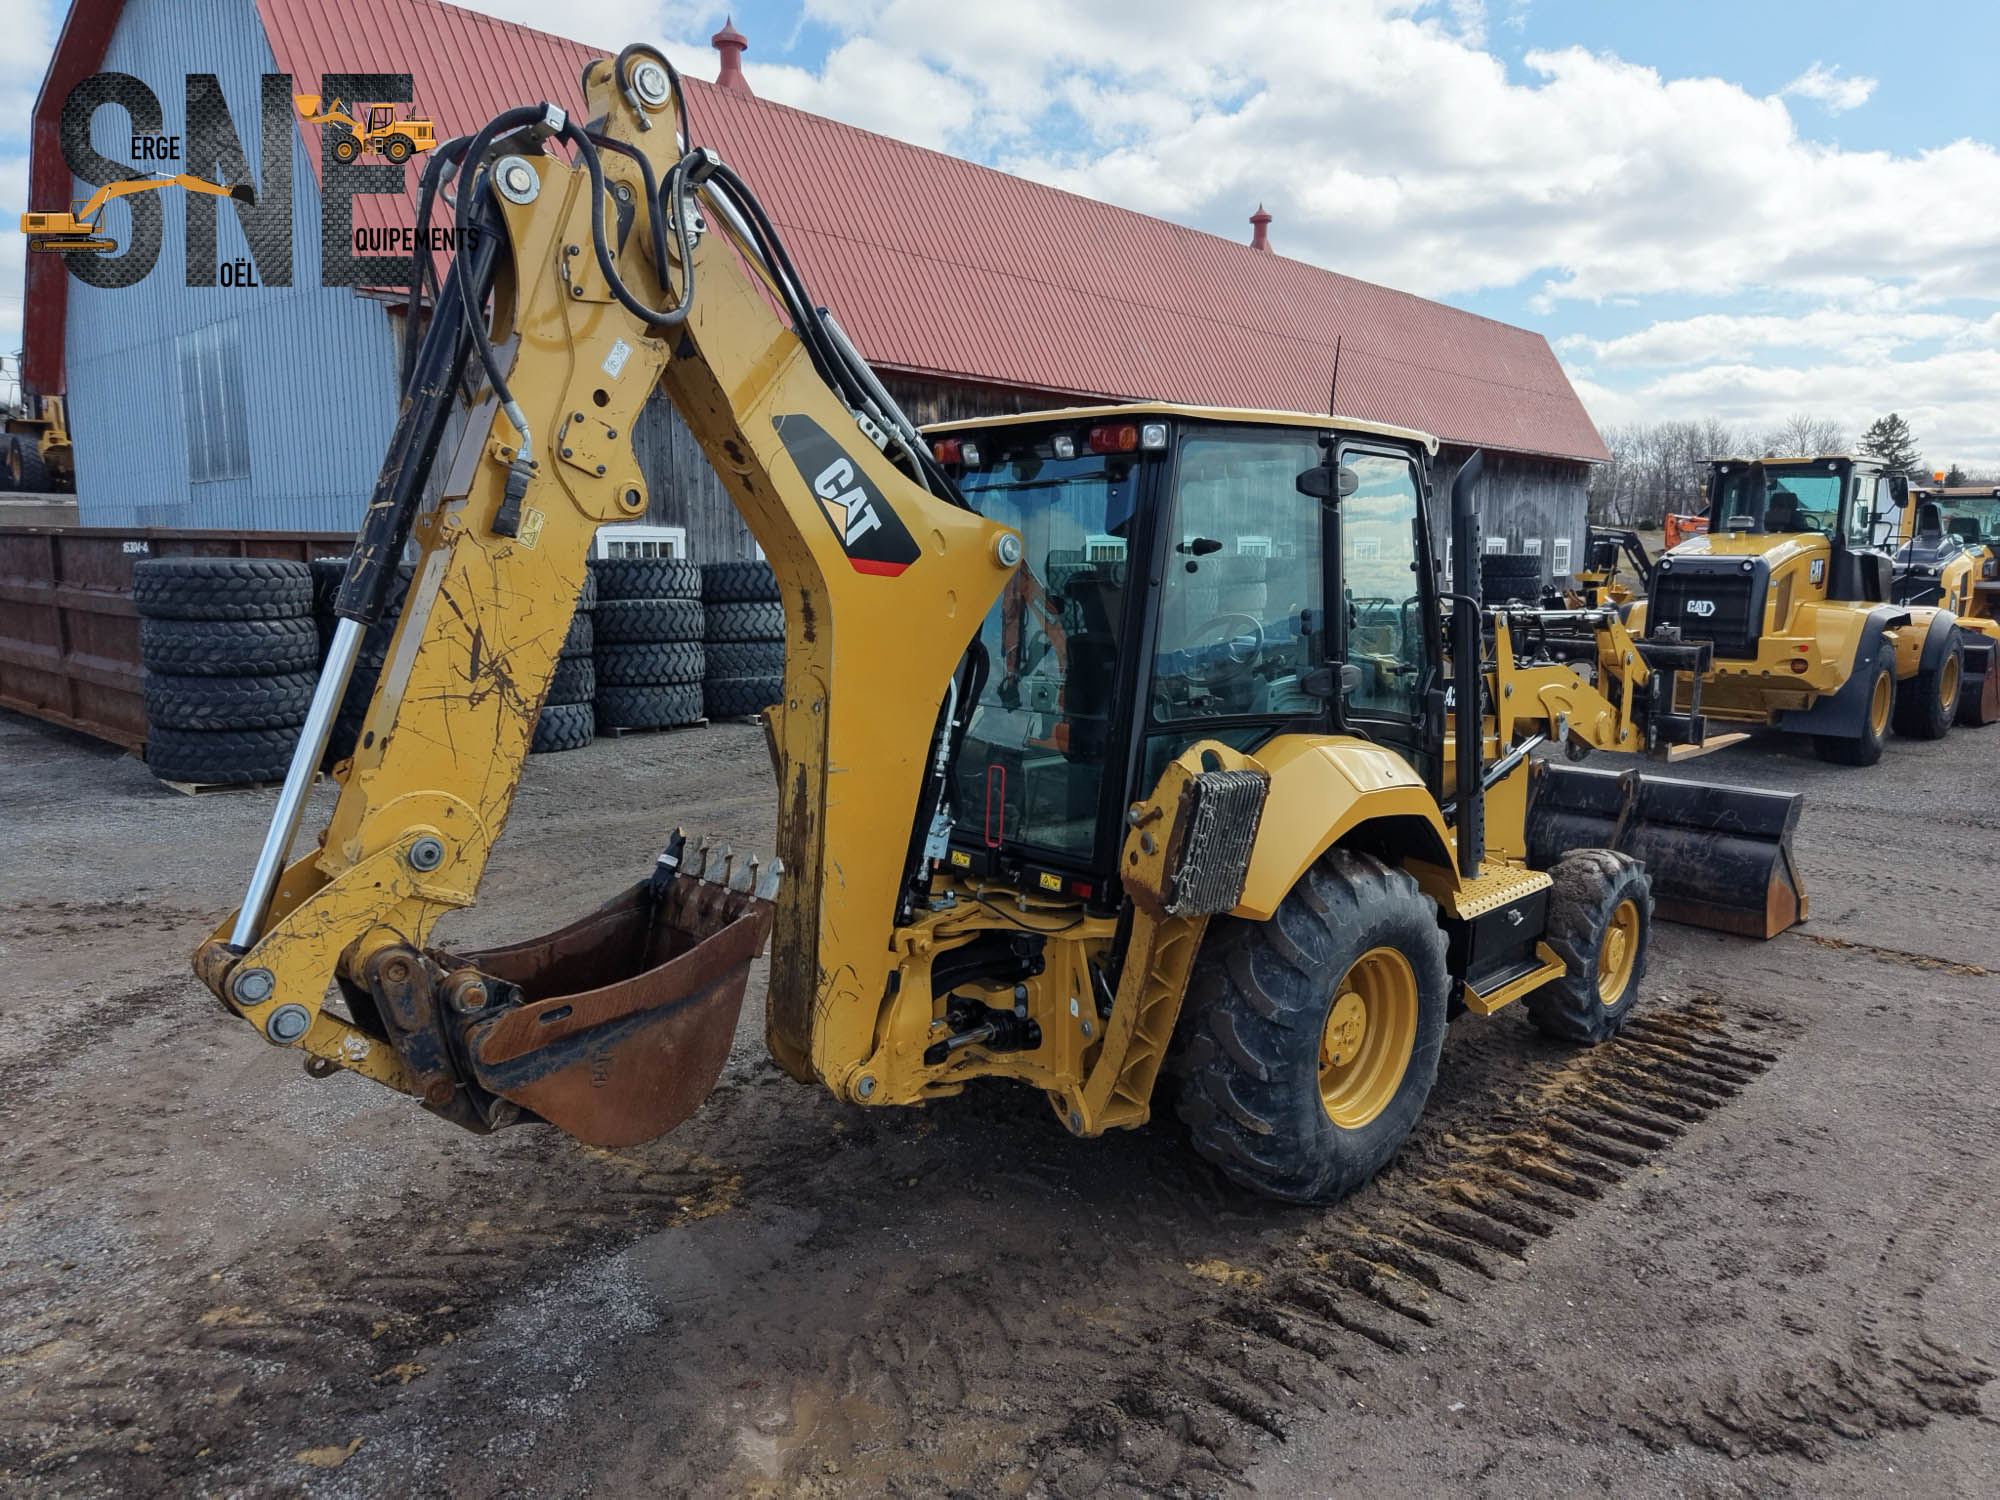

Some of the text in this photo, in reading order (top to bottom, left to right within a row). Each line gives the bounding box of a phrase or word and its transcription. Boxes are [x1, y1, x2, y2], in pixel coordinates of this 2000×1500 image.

[814, 458, 882, 547] CAT
[1810, 559, 1824, 584] CAT
[1687, 600, 1715, 616] CAT
